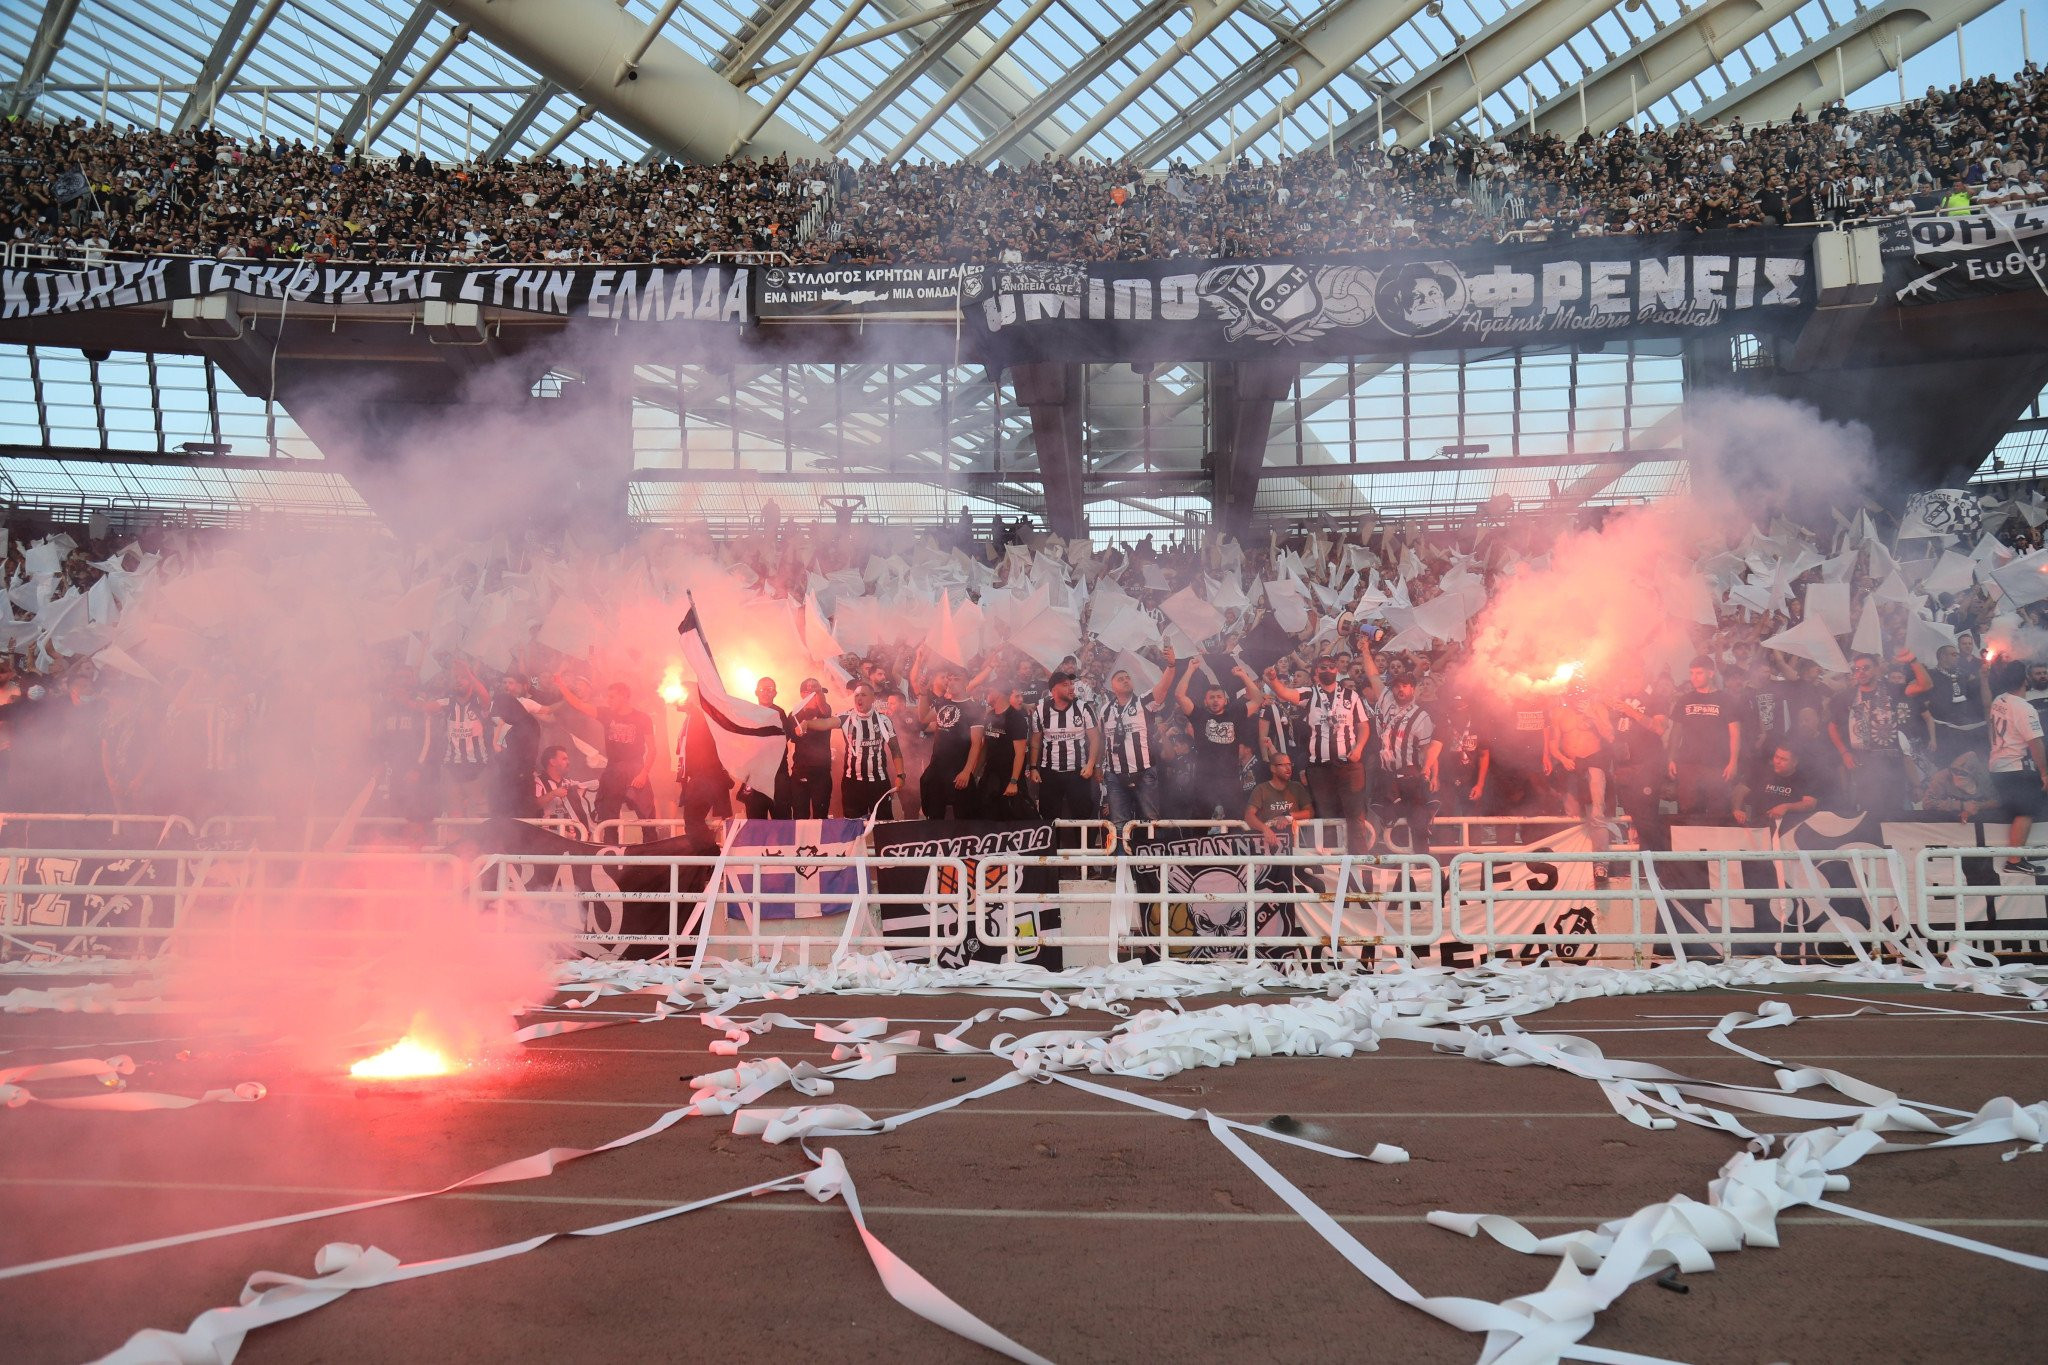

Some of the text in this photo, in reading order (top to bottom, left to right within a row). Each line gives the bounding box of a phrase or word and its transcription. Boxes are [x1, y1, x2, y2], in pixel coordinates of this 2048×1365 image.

[787, 270, 862, 285] ΣΥΛΛΟΓΟΣ
[866, 268, 923, 283] ΚΡΗΤΩΝ
[927, 265, 985, 281] ΑΙΓΑΛΕΩ
[588, 267, 748, 323] ΕΛΛΑΔΑ
[764, 292, 788, 304] ΕΝΑ
[790, 290, 818, 303] ΝΗΣΙ
[892, 288, 914, 299] ΜΙΑ
[916, 286, 958, 299] ΟΜΑΔΑ
[1048, 283, 1075, 293] GATE
[1469, 255, 1807, 318] ΦΡΕΝΕΙΣ
[1462, 297, 1723, 342] Against Modern Football
[1050, 732, 1076, 740] MINOAN
[1765, 784, 1793, 794] HUGO
[1269, 803, 1294, 811] STAFF
